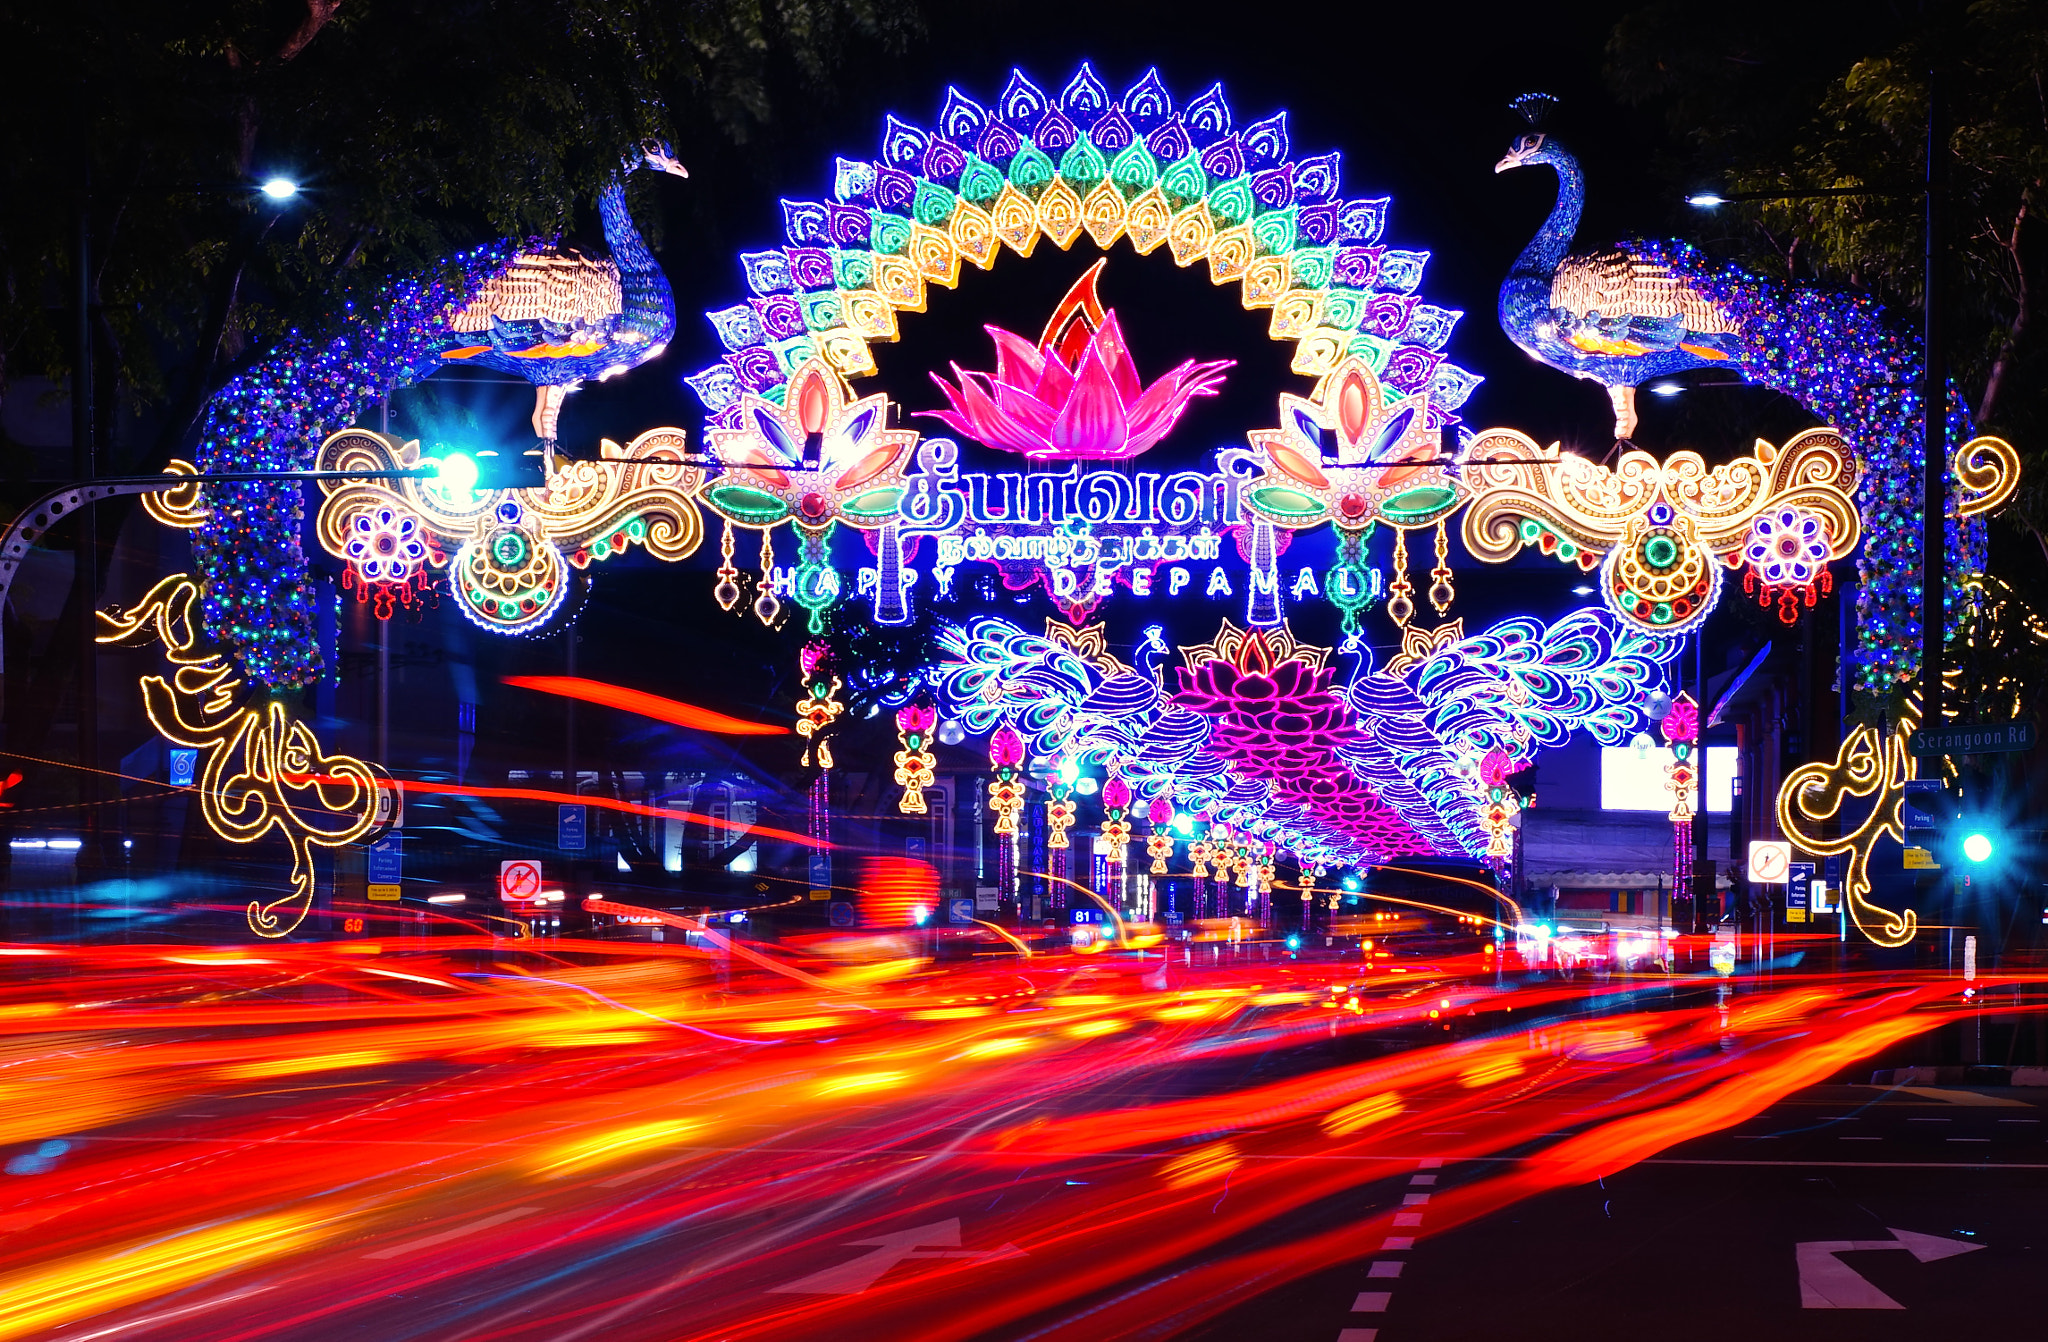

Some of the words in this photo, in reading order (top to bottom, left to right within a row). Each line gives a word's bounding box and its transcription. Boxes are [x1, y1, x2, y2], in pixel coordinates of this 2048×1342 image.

[898, 438, 1266, 539] தீபாவளி
[937, 528, 1221, 571] நல்வாழ்த்துக்கள்
[774, 567, 955, 596] HAPPY
[1051, 567, 1383, 596] DEEPAVALI
[1917, 731, 2002, 750] Serangoon
[2008, 726, 2027, 743] Rd
[344, 918, 364, 933] 60
[1075, 910, 1090, 923] 81
